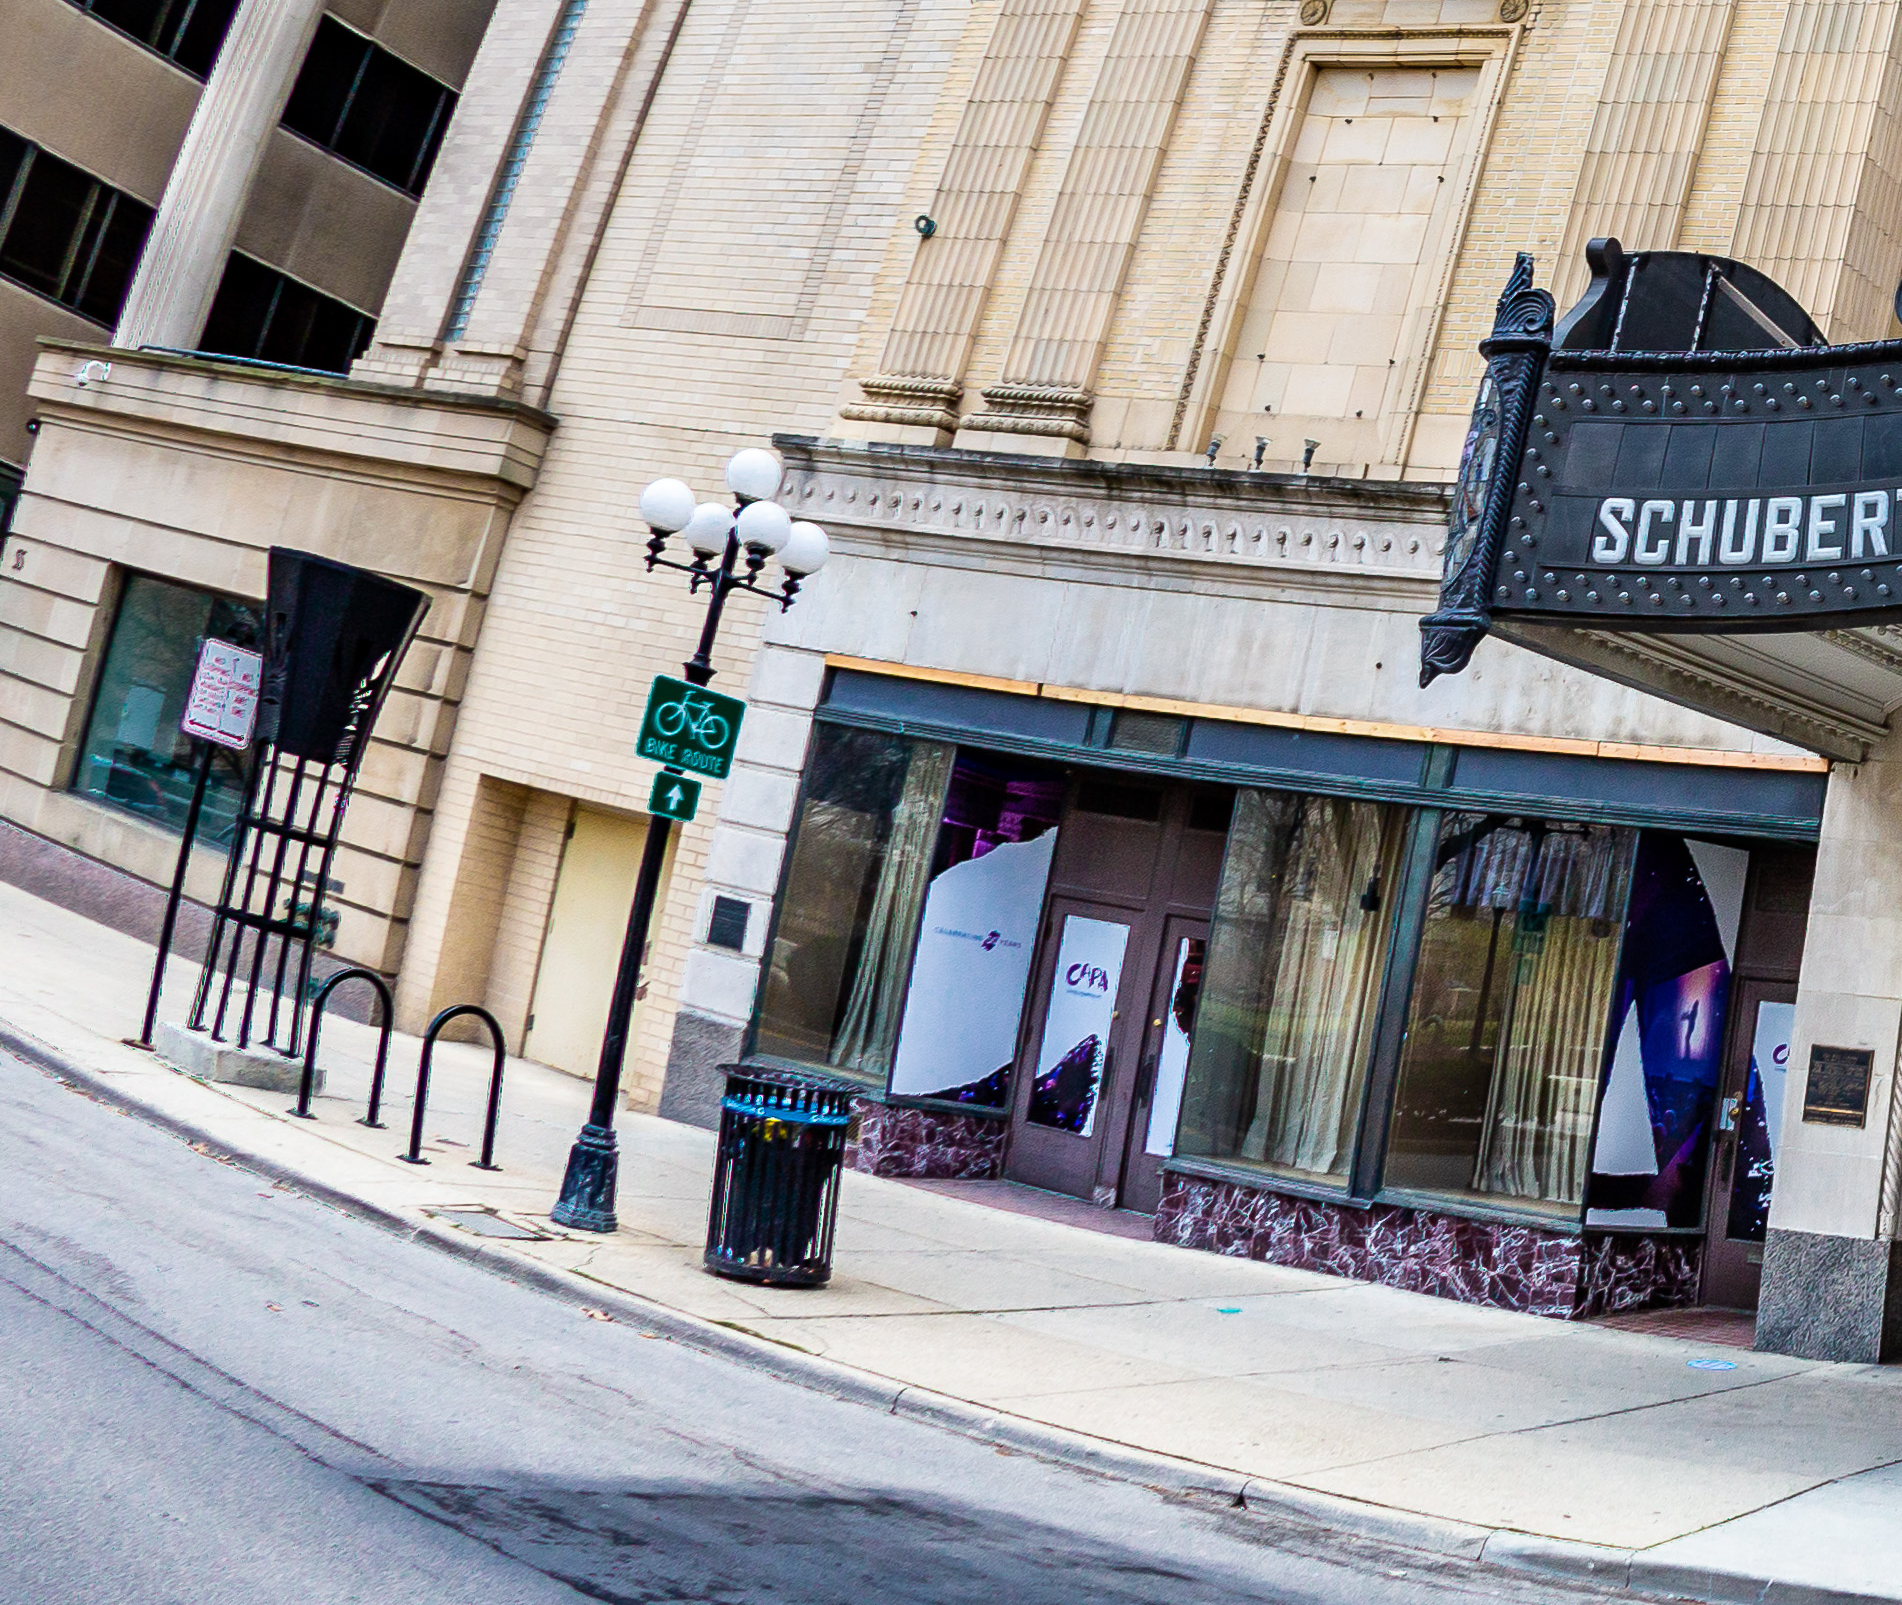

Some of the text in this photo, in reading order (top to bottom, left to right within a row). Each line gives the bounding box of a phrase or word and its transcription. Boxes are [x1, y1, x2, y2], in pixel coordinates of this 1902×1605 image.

[643, 736, 725, 774] BIKE ROUTE
[1066, 963, 1109, 992] CAPA
